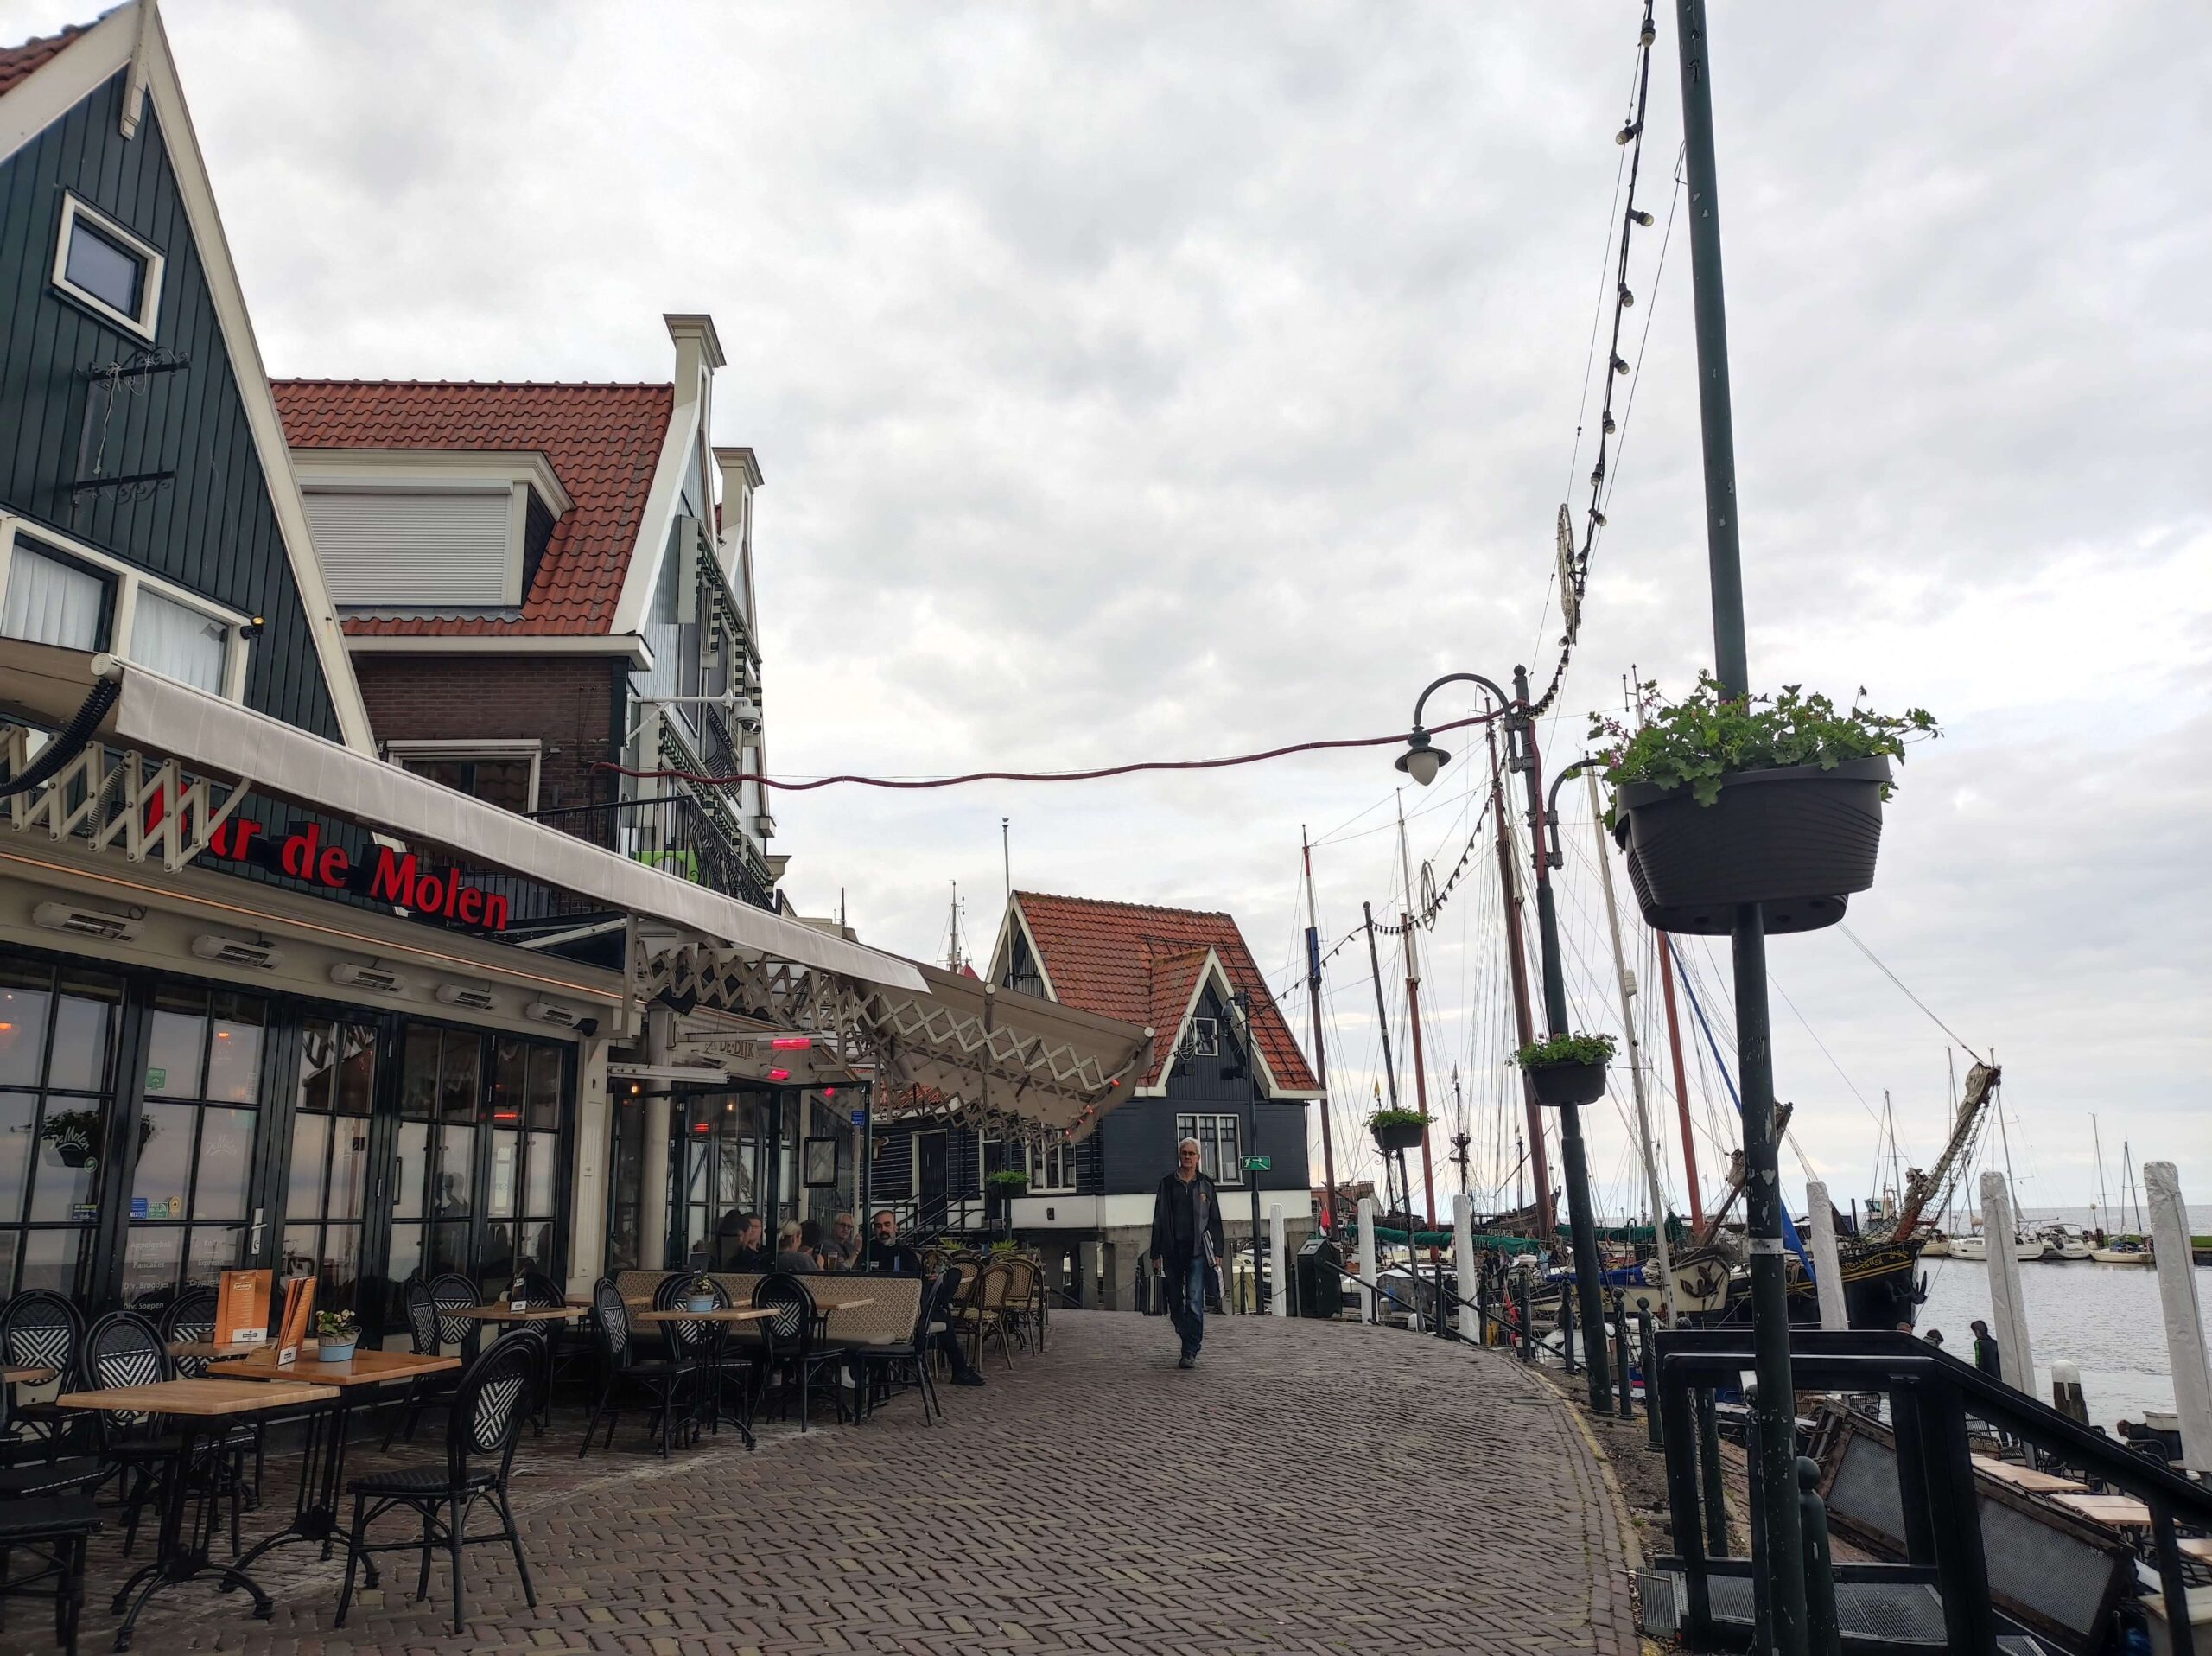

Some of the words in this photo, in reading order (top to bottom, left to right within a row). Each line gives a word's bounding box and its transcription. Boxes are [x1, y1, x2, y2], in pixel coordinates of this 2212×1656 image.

[282, 823, 349, 888] de
[370, 845, 508, 930] Molen
[133, 1260, 165, 1269] Pancakes
[123, 1303, 137, 1311] Div.
[138, 1303, 164, 1311] Soepen
